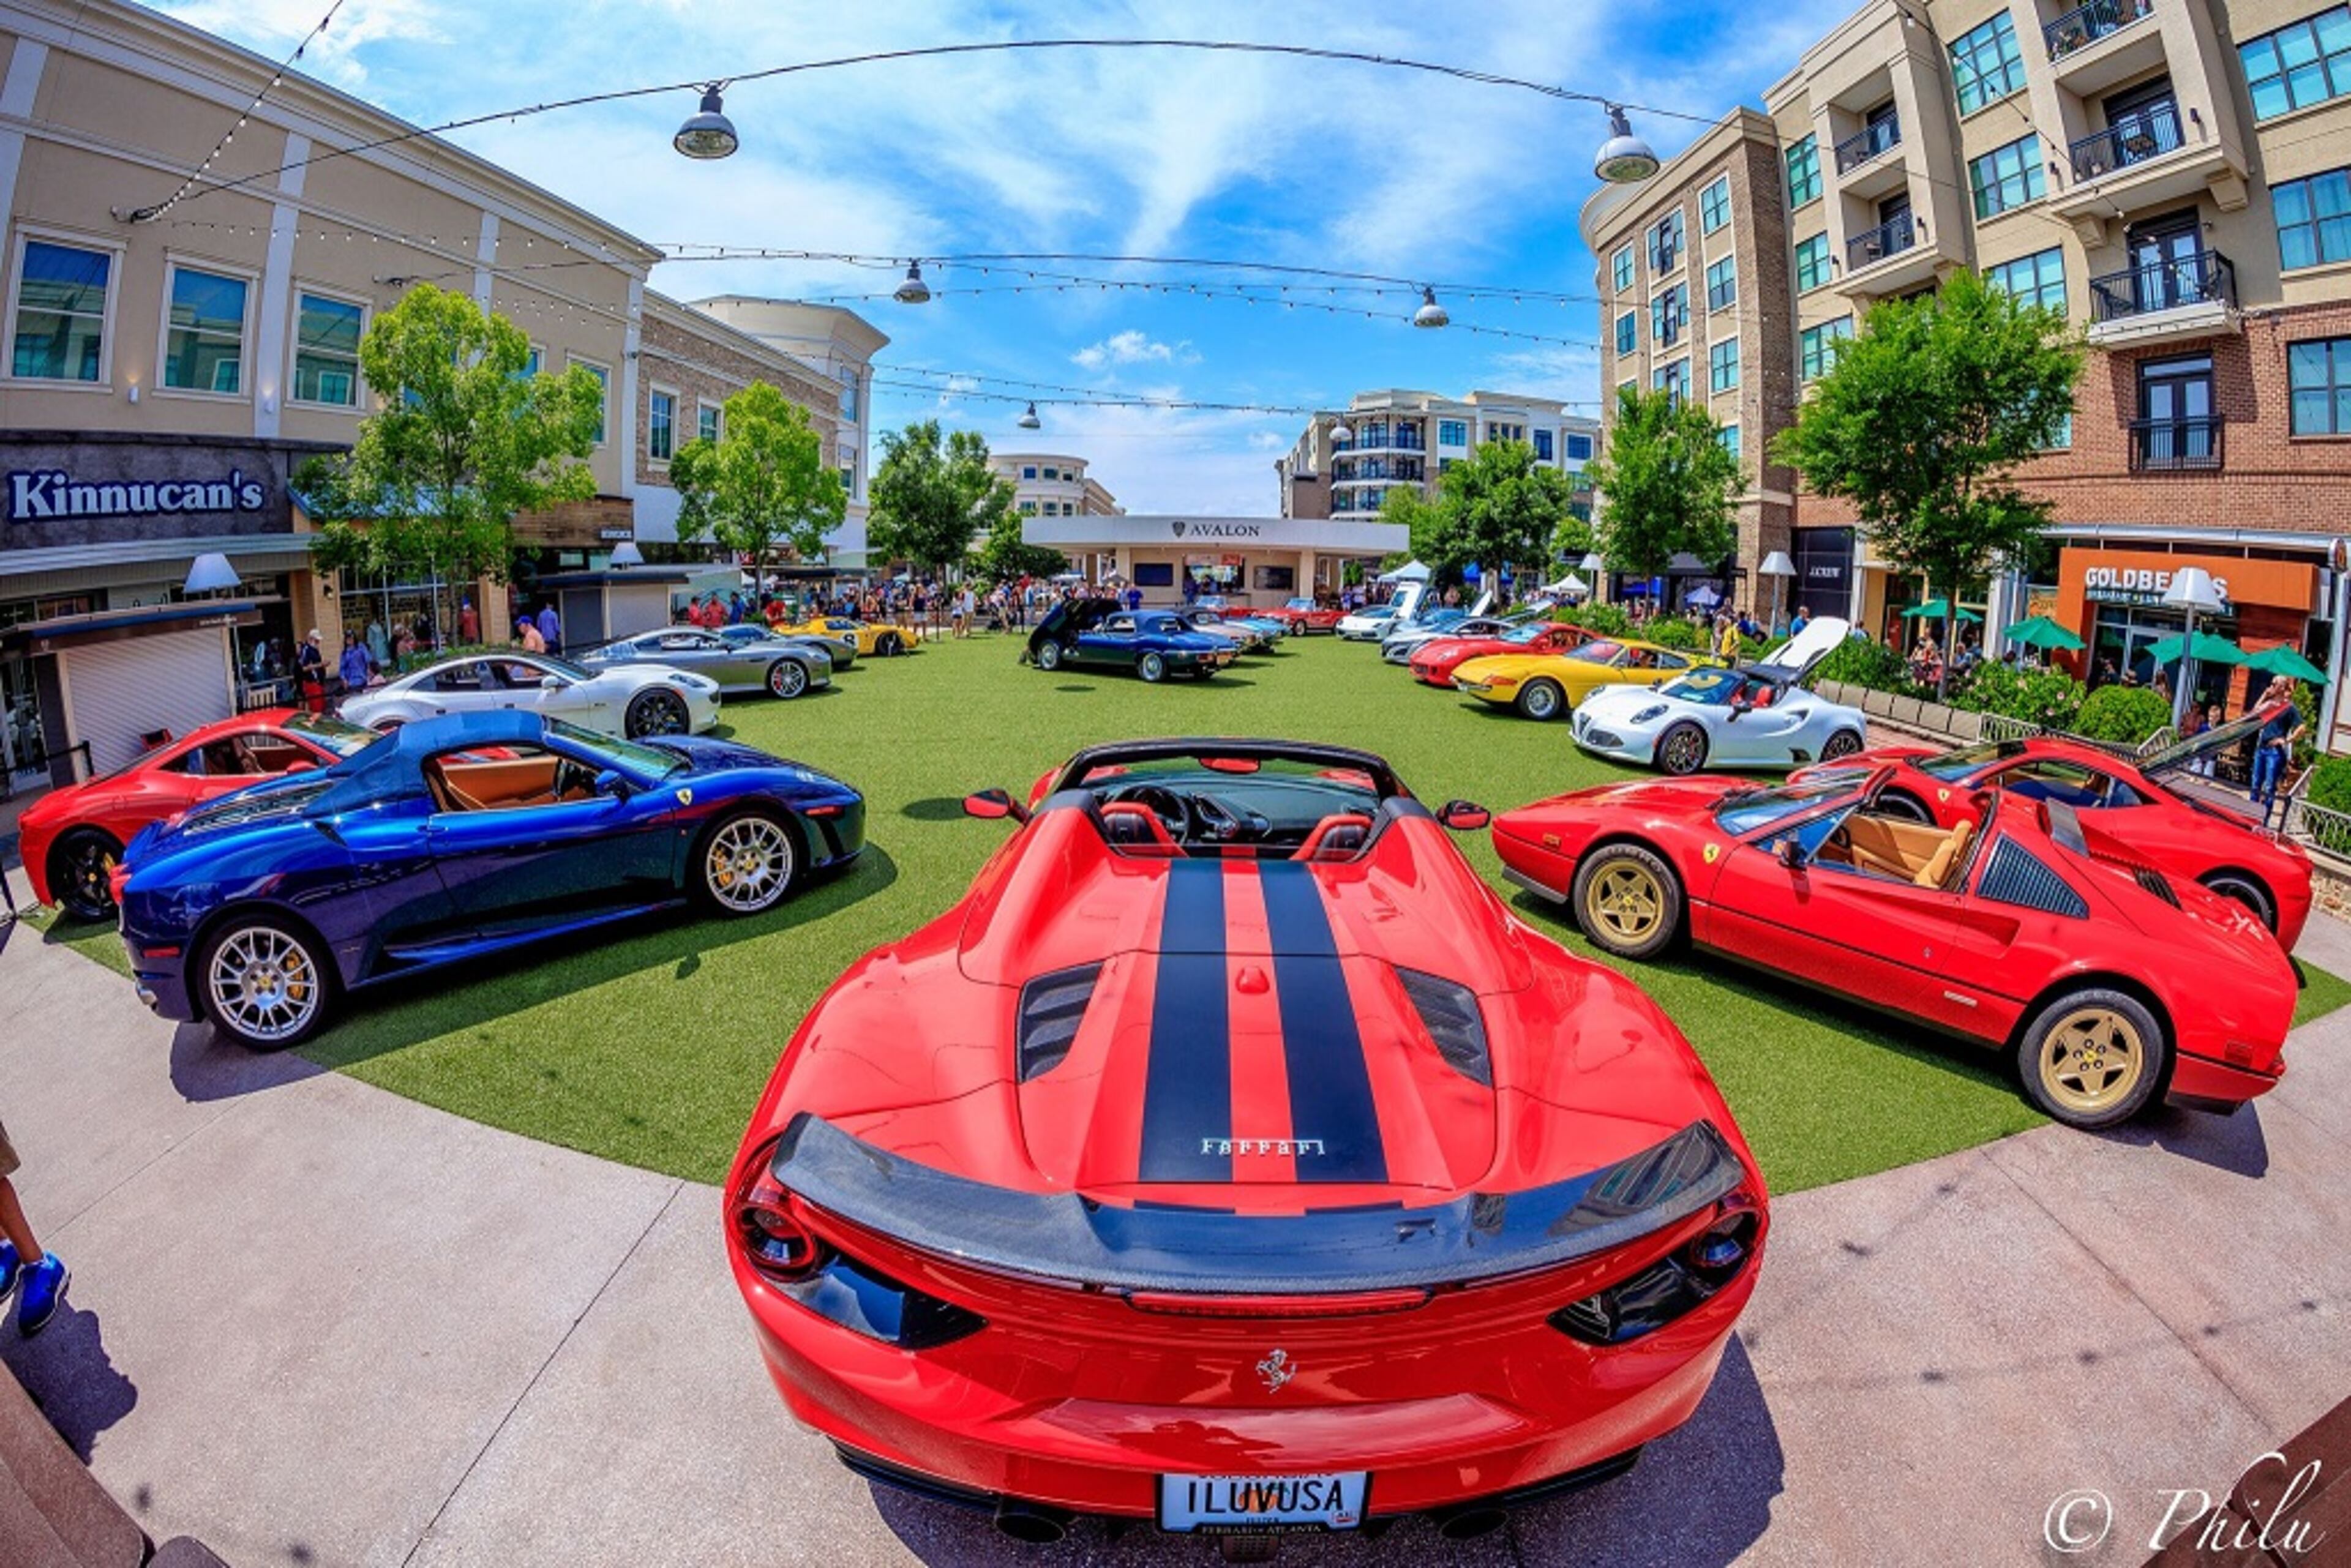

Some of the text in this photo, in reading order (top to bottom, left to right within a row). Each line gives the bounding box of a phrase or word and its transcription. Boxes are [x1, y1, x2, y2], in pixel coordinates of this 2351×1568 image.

[12, 470, 263, 519] Kinnucan's
[1190, 523, 1261, 537] AVALON
[2085, 567, 2229, 599] GOLDBES
[1200, 1138, 1326, 1155] Ferrari
[1188, 1480, 1344, 1514] ILUVUSA
